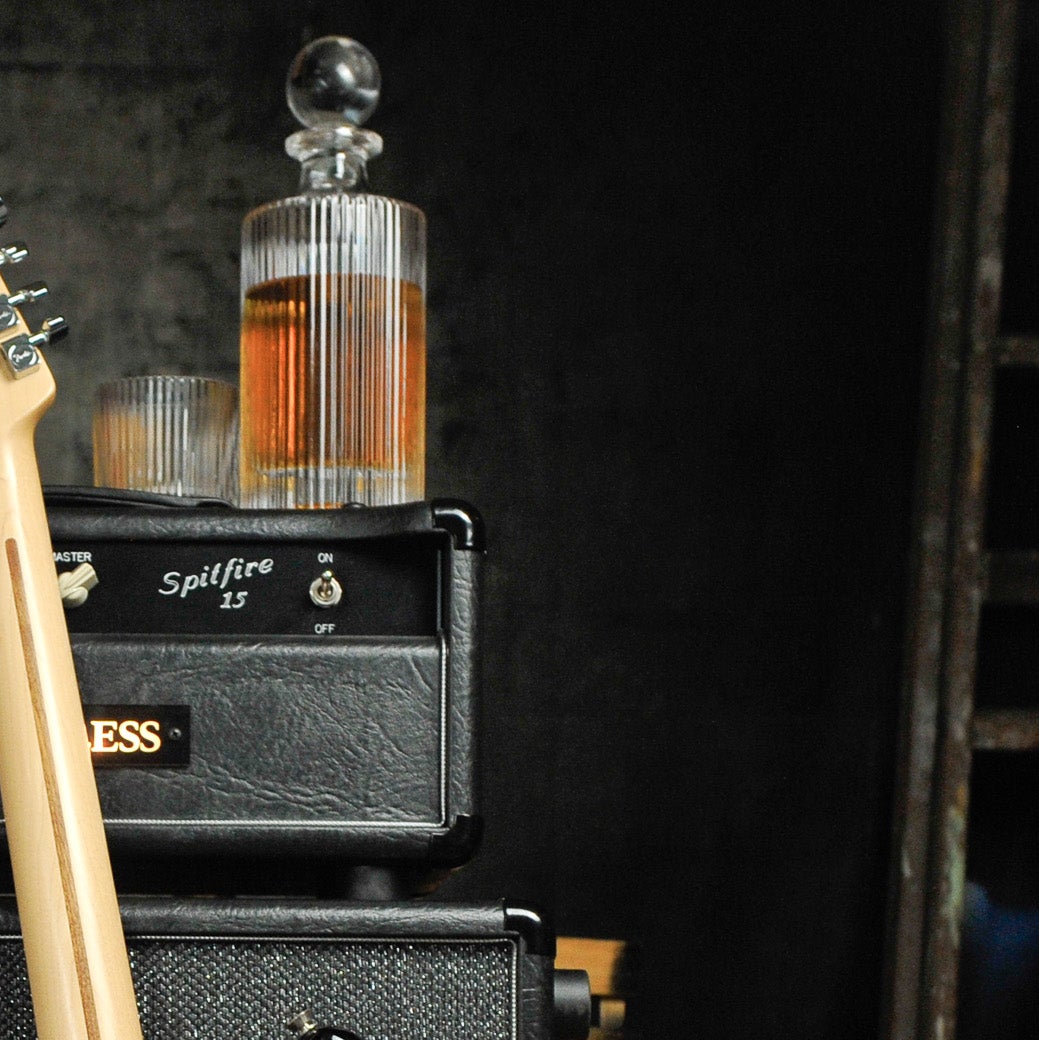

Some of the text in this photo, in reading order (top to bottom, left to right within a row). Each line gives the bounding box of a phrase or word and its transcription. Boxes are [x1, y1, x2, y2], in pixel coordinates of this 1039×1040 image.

[317, 552, 334, 564] ON
[158, 557, 274, 598] Spitfire
[219, 591, 248, 609] 15
[314, 623, 336, 634] OFF
